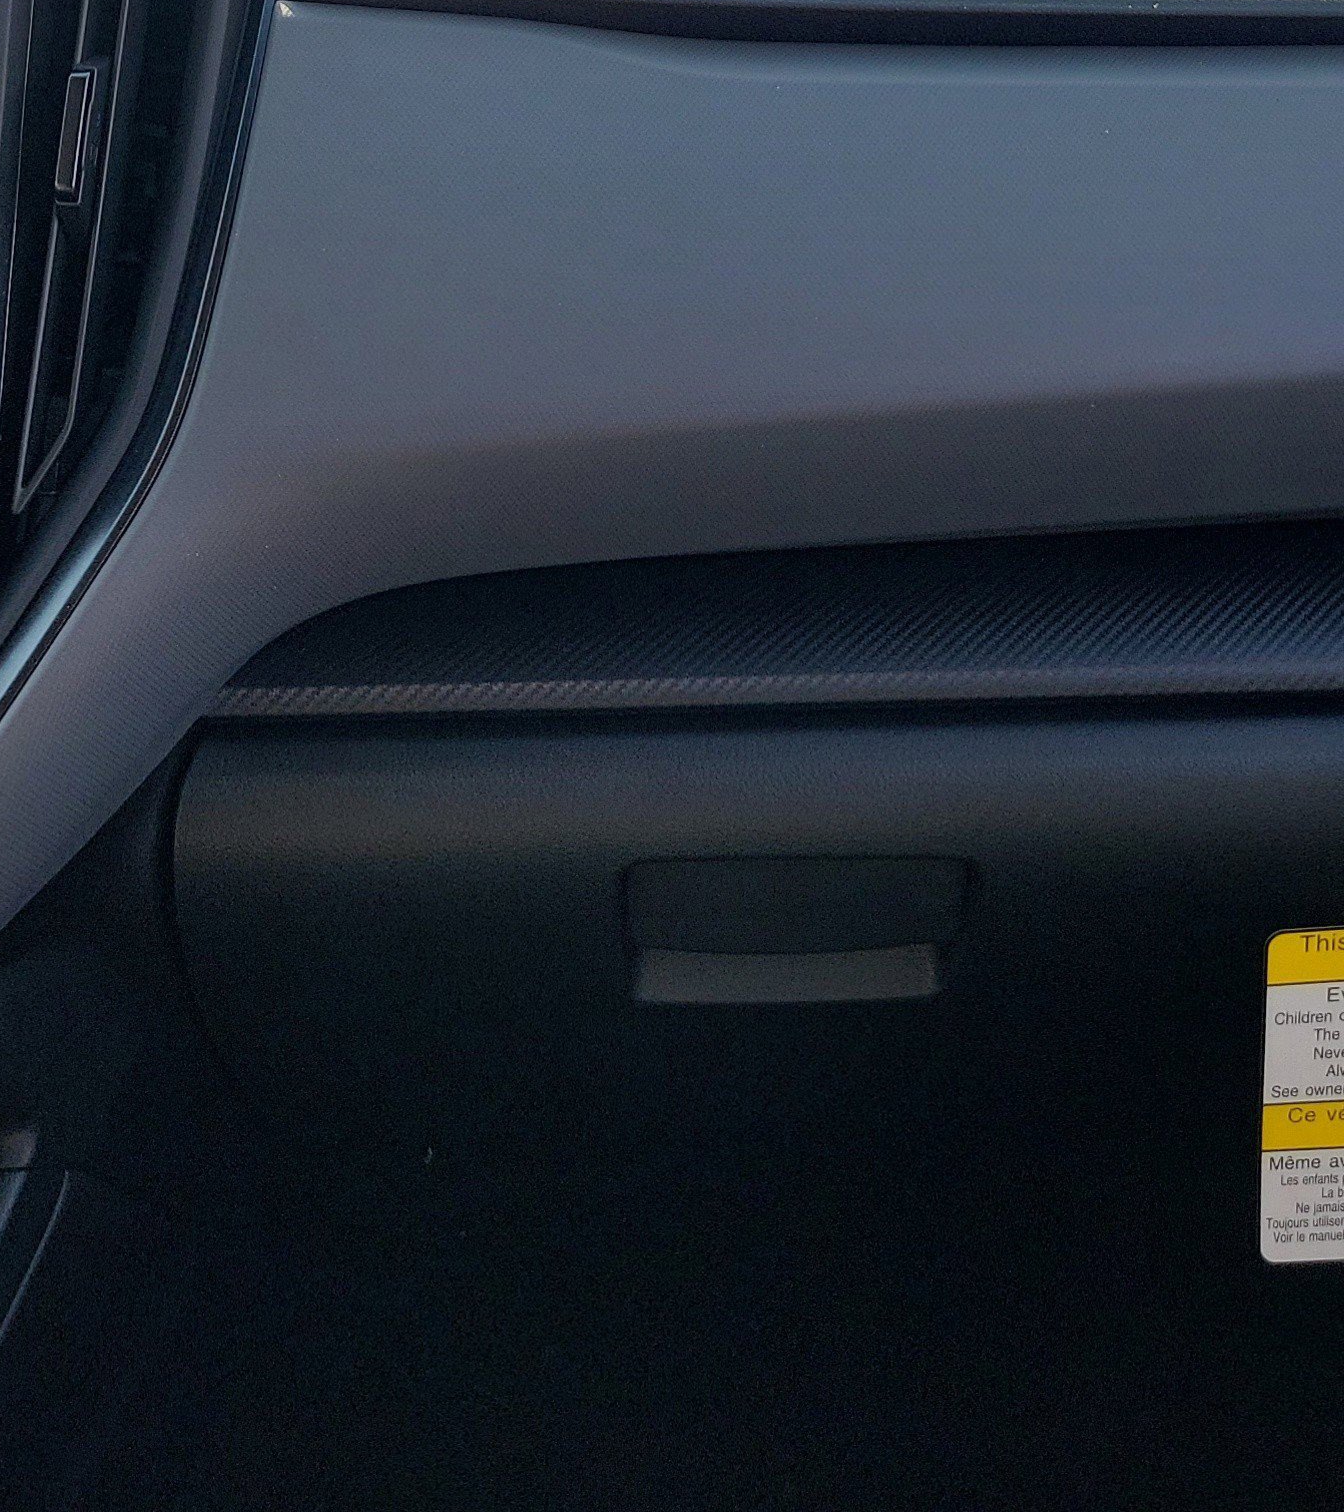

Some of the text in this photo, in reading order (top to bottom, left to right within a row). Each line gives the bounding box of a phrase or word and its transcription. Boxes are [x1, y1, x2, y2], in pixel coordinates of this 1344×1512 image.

[1274, 1011, 1332, 1025] Children
[1313, 1027, 1340, 1040] The
[1270, 1084, 1298, 1098] See
[1287, 1106, 1316, 1123] Ce
[1268, 1155, 1321, 1170] Même
[1280, 1174, 1299, 1186] Les
[1301, 1173, 1339, 1185] enfants
